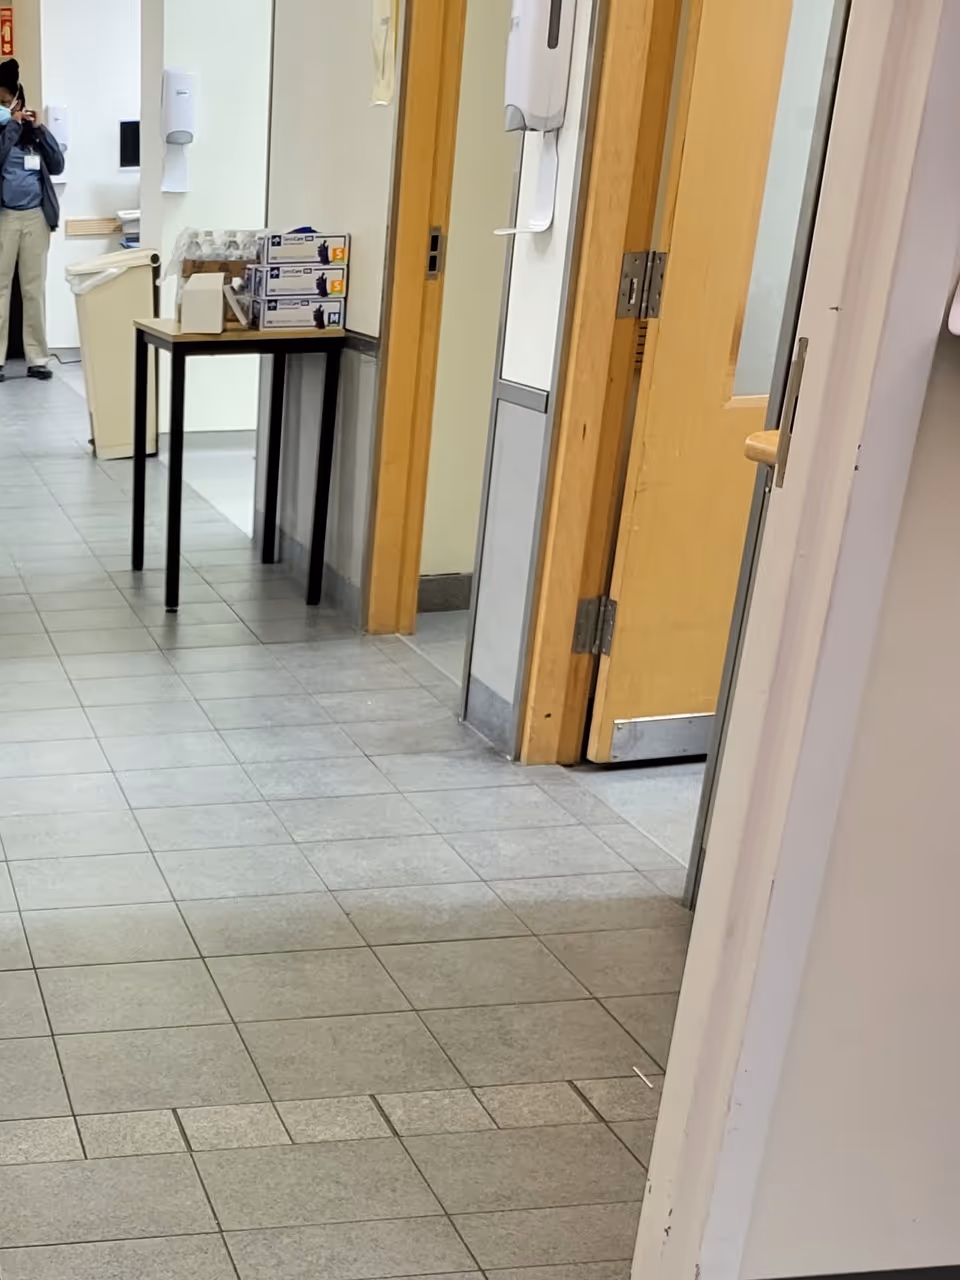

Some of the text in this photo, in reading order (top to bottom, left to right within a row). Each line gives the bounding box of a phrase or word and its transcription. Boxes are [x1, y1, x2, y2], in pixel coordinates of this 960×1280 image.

[336, 249, 342, 258] S
[333, 281, 340, 290] S
[330, 313, 339, 323] M
